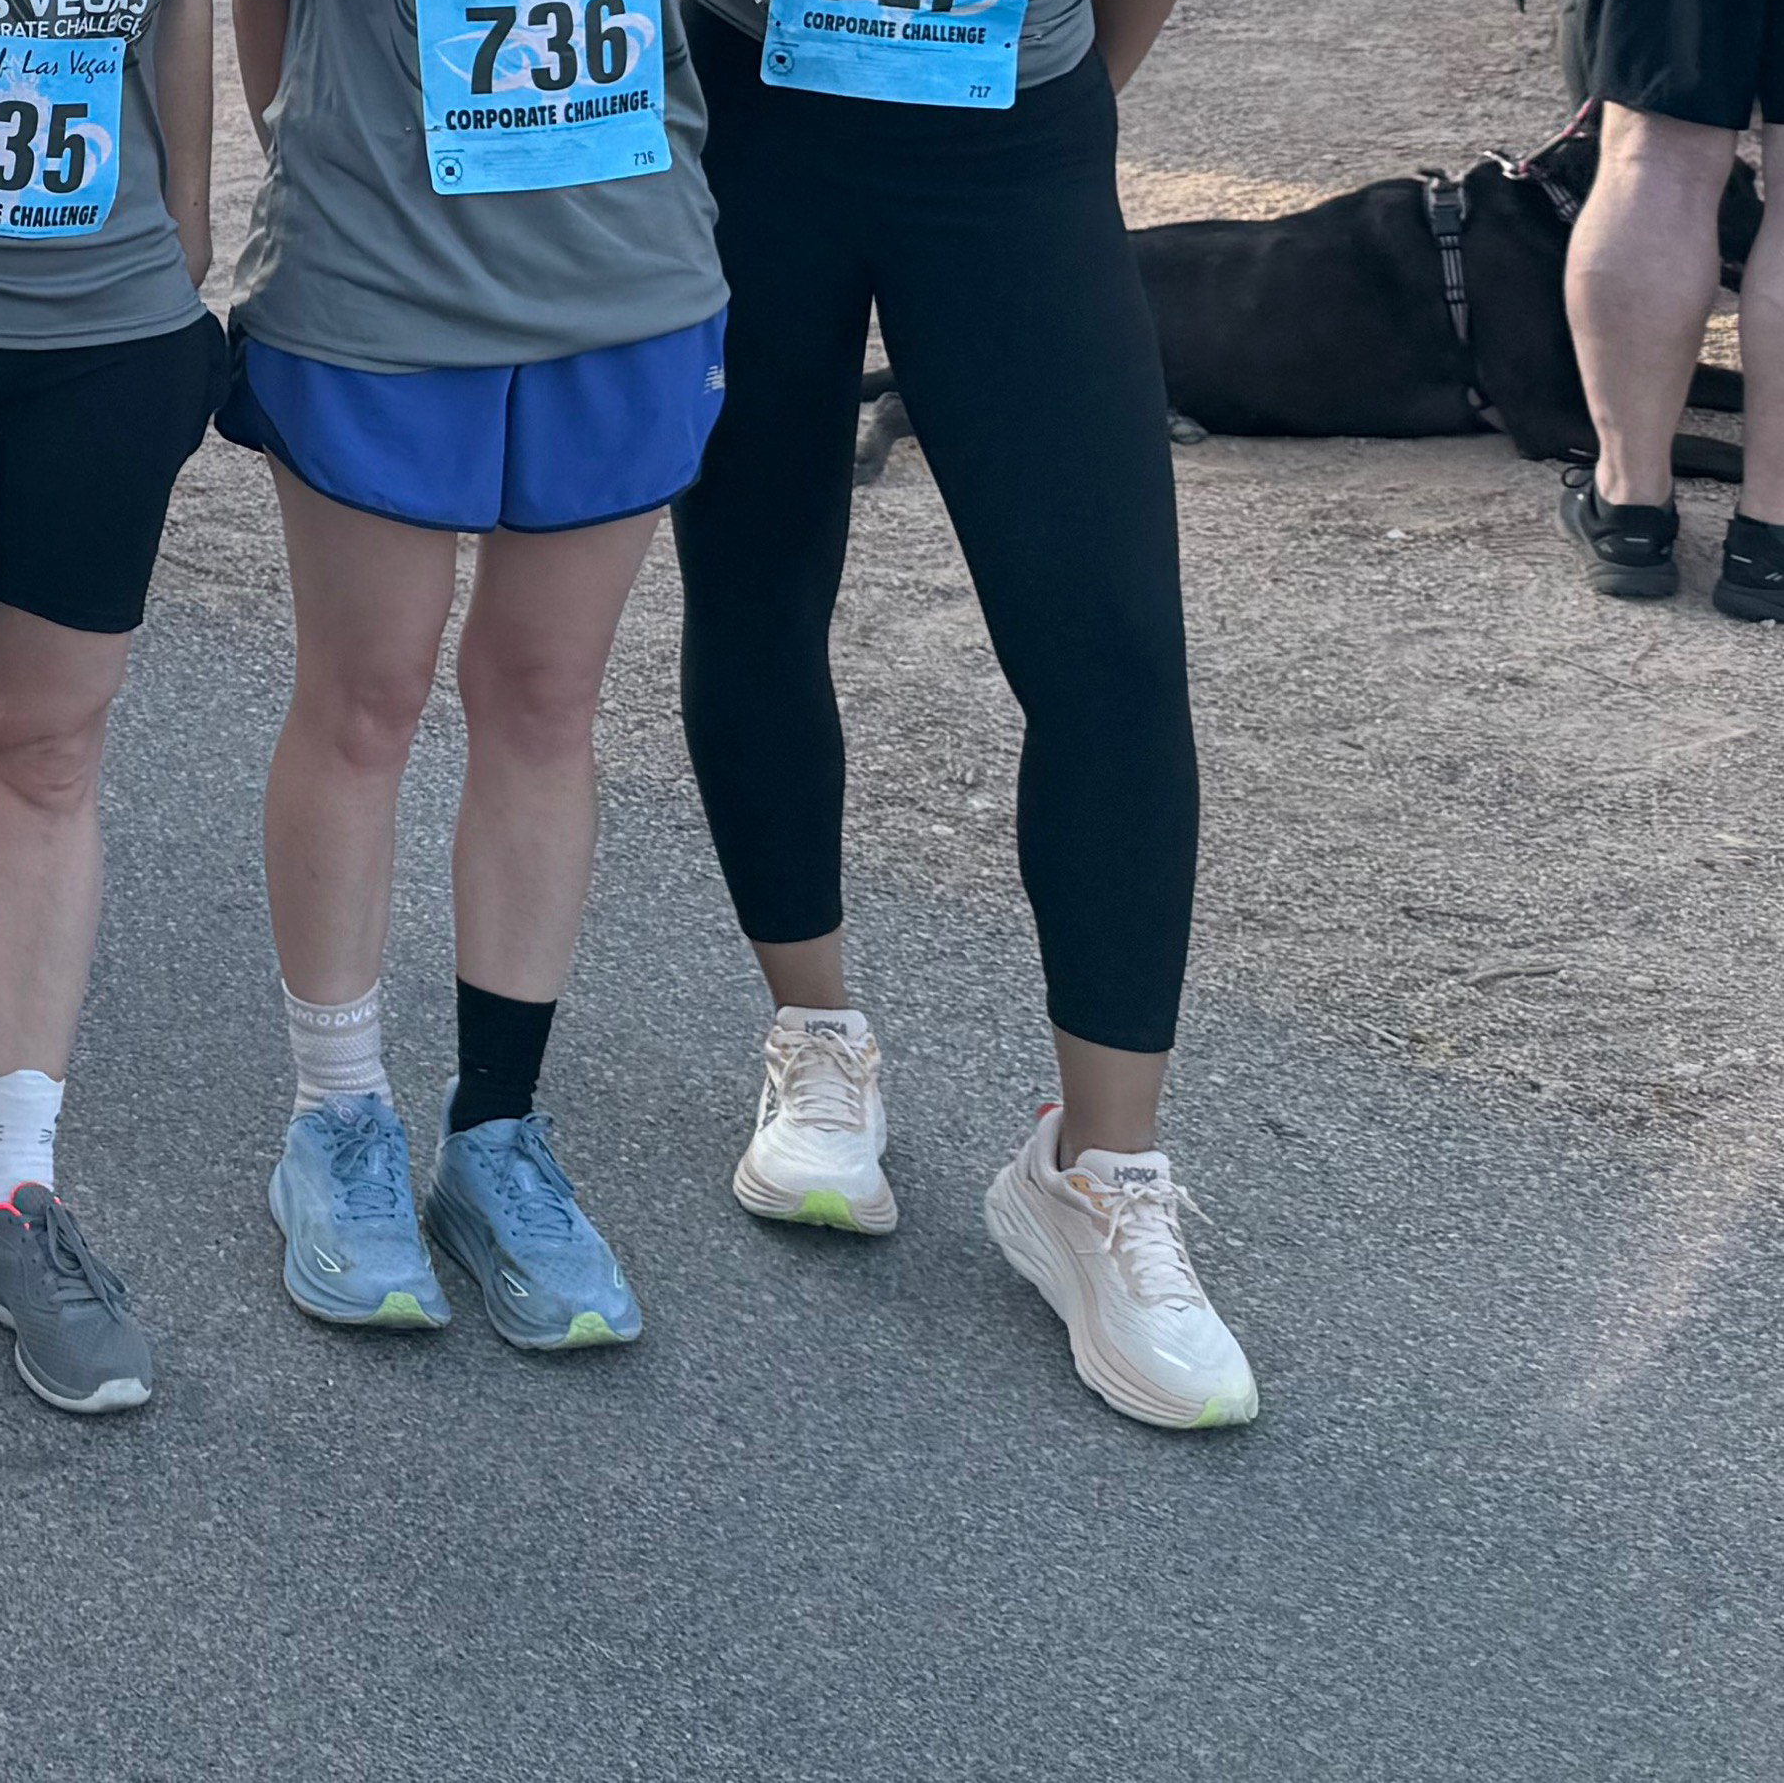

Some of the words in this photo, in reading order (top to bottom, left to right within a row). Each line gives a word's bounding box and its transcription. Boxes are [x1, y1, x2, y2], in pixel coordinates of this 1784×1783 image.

[803, 11, 896, 39] CORPORATE
[903, 23, 986, 45] CHALLENGE
[22, 50, 58, 75] Las
[70, 50, 116, 83] Vegas
[969, 85, 992, 98] 717
[446, 104, 557, 131] CORPORATE
[564, 90, 649, 123] CHALLENGE
[634, 151, 655, 166] 736
[9, 203, 99, 227] CHALLENGE
